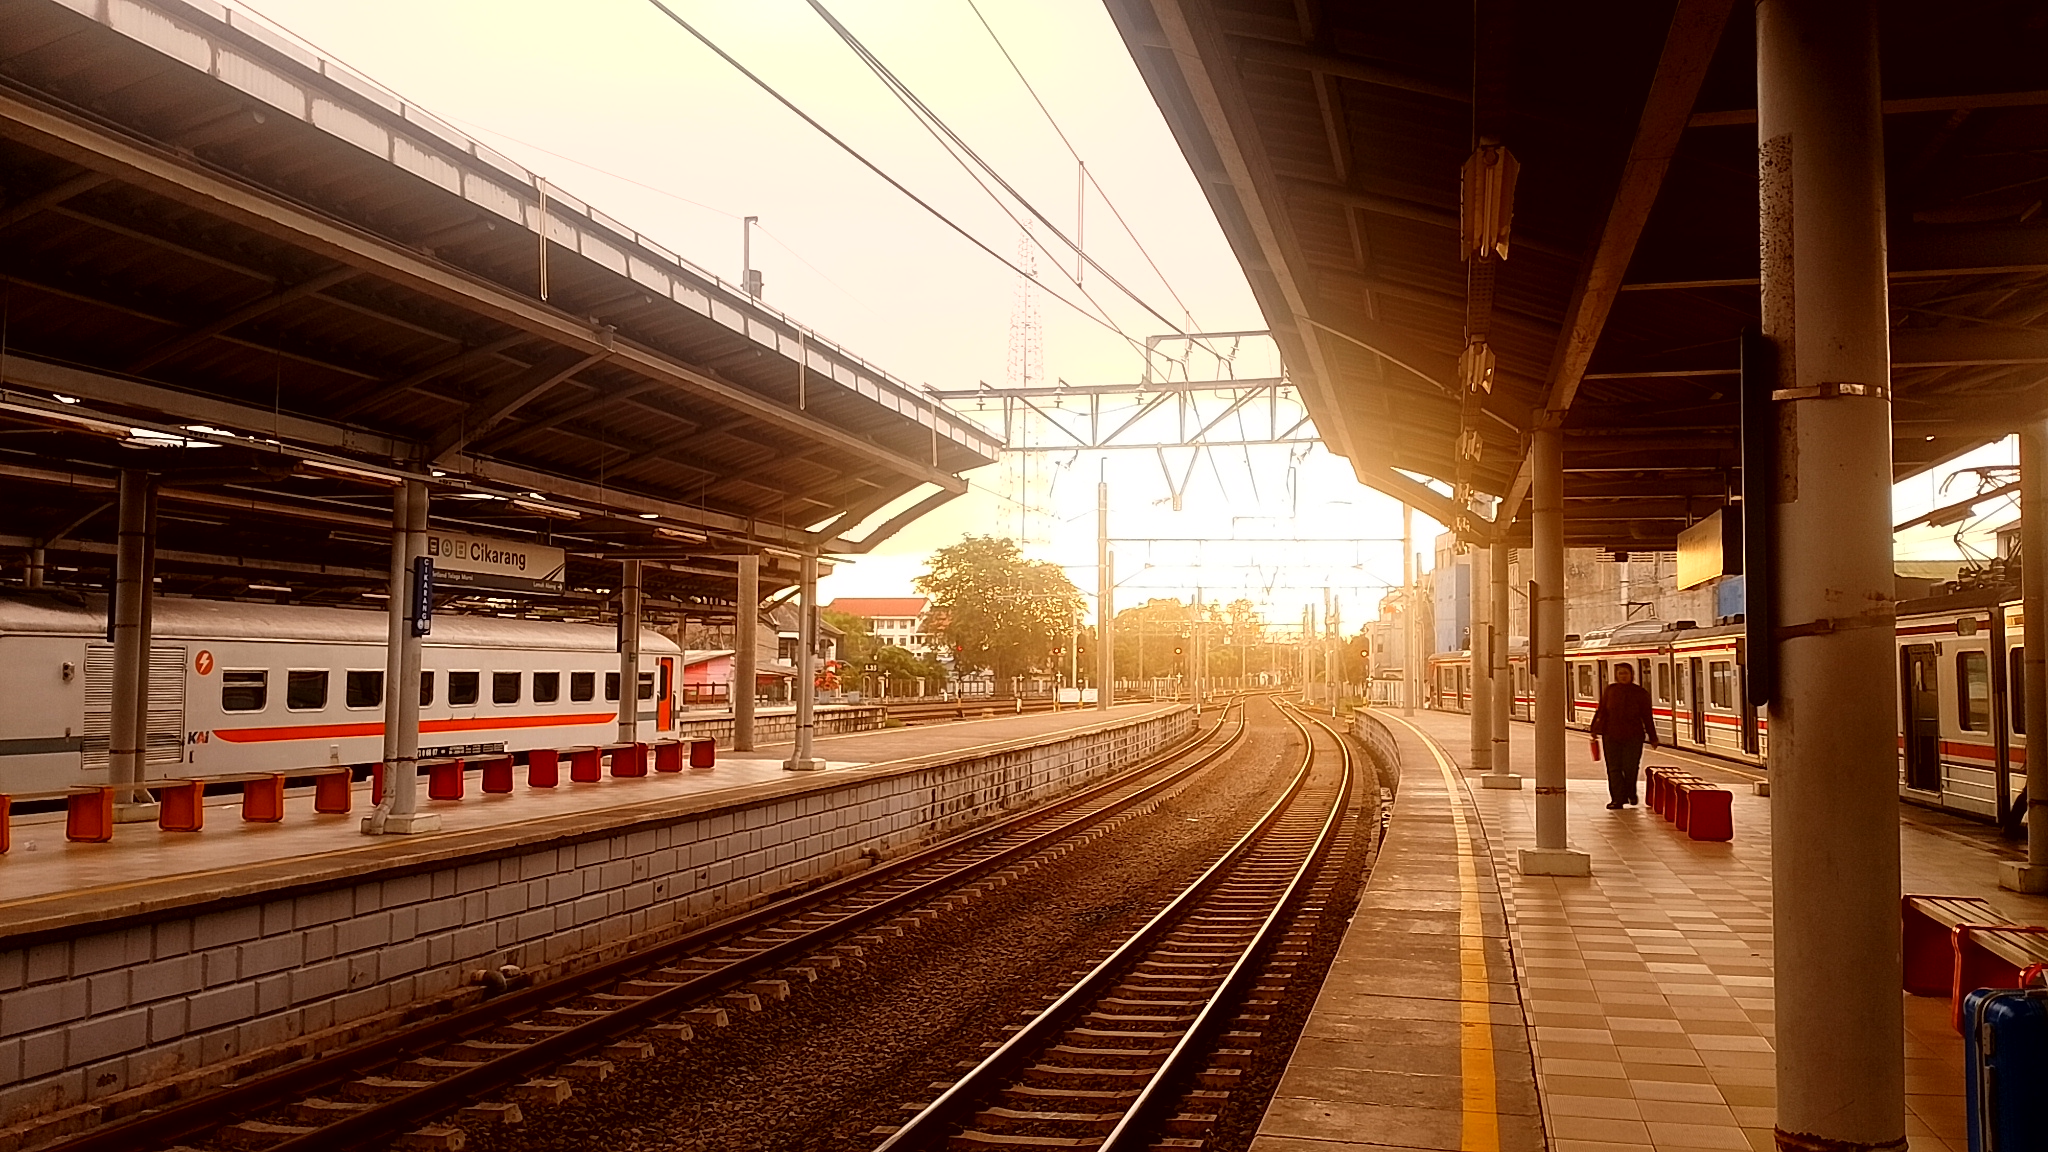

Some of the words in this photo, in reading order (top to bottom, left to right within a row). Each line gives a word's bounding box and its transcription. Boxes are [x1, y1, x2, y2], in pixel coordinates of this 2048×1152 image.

[470, 542, 526, 571] Cikarang
[422, 559, 430, 619] CIKARANG
[1463, 626, 1470, 635] 3
[187, 730, 210, 745] KAI
